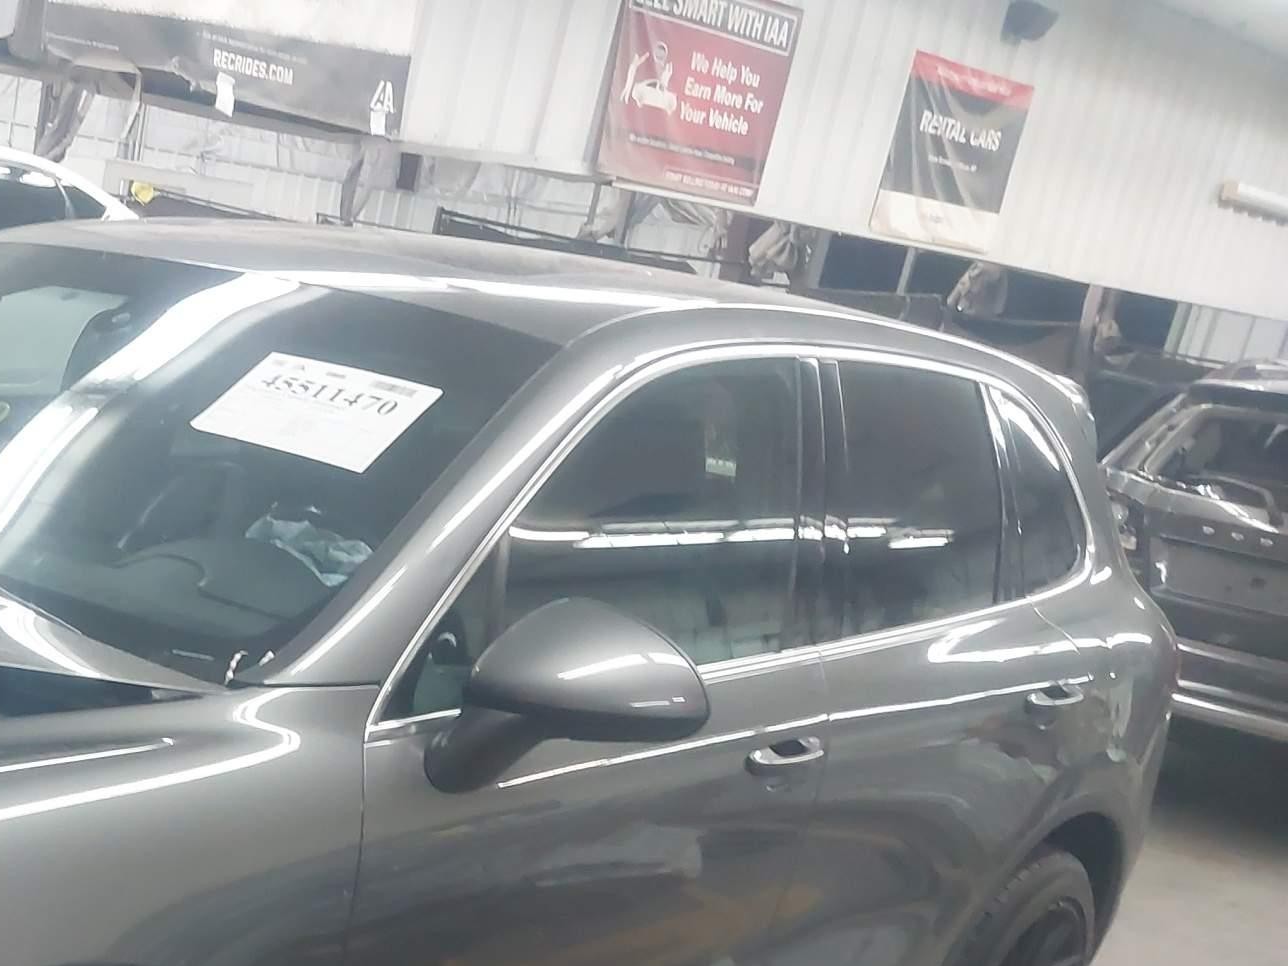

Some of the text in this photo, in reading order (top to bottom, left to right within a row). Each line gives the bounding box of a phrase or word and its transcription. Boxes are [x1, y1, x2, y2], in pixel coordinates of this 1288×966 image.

[672, 0, 789, 48] SMART WITH IAA
[213, 47, 294, 86] RECRIDES.COM
[690, 51, 761, 89] We Help You
[684, 76, 764, 114] Earn More For
[680, 101, 749, 136] Your Vehicle
[919, 109, 1002, 152] RENTAL CARS
[262, 374, 399, 416] 45511470
